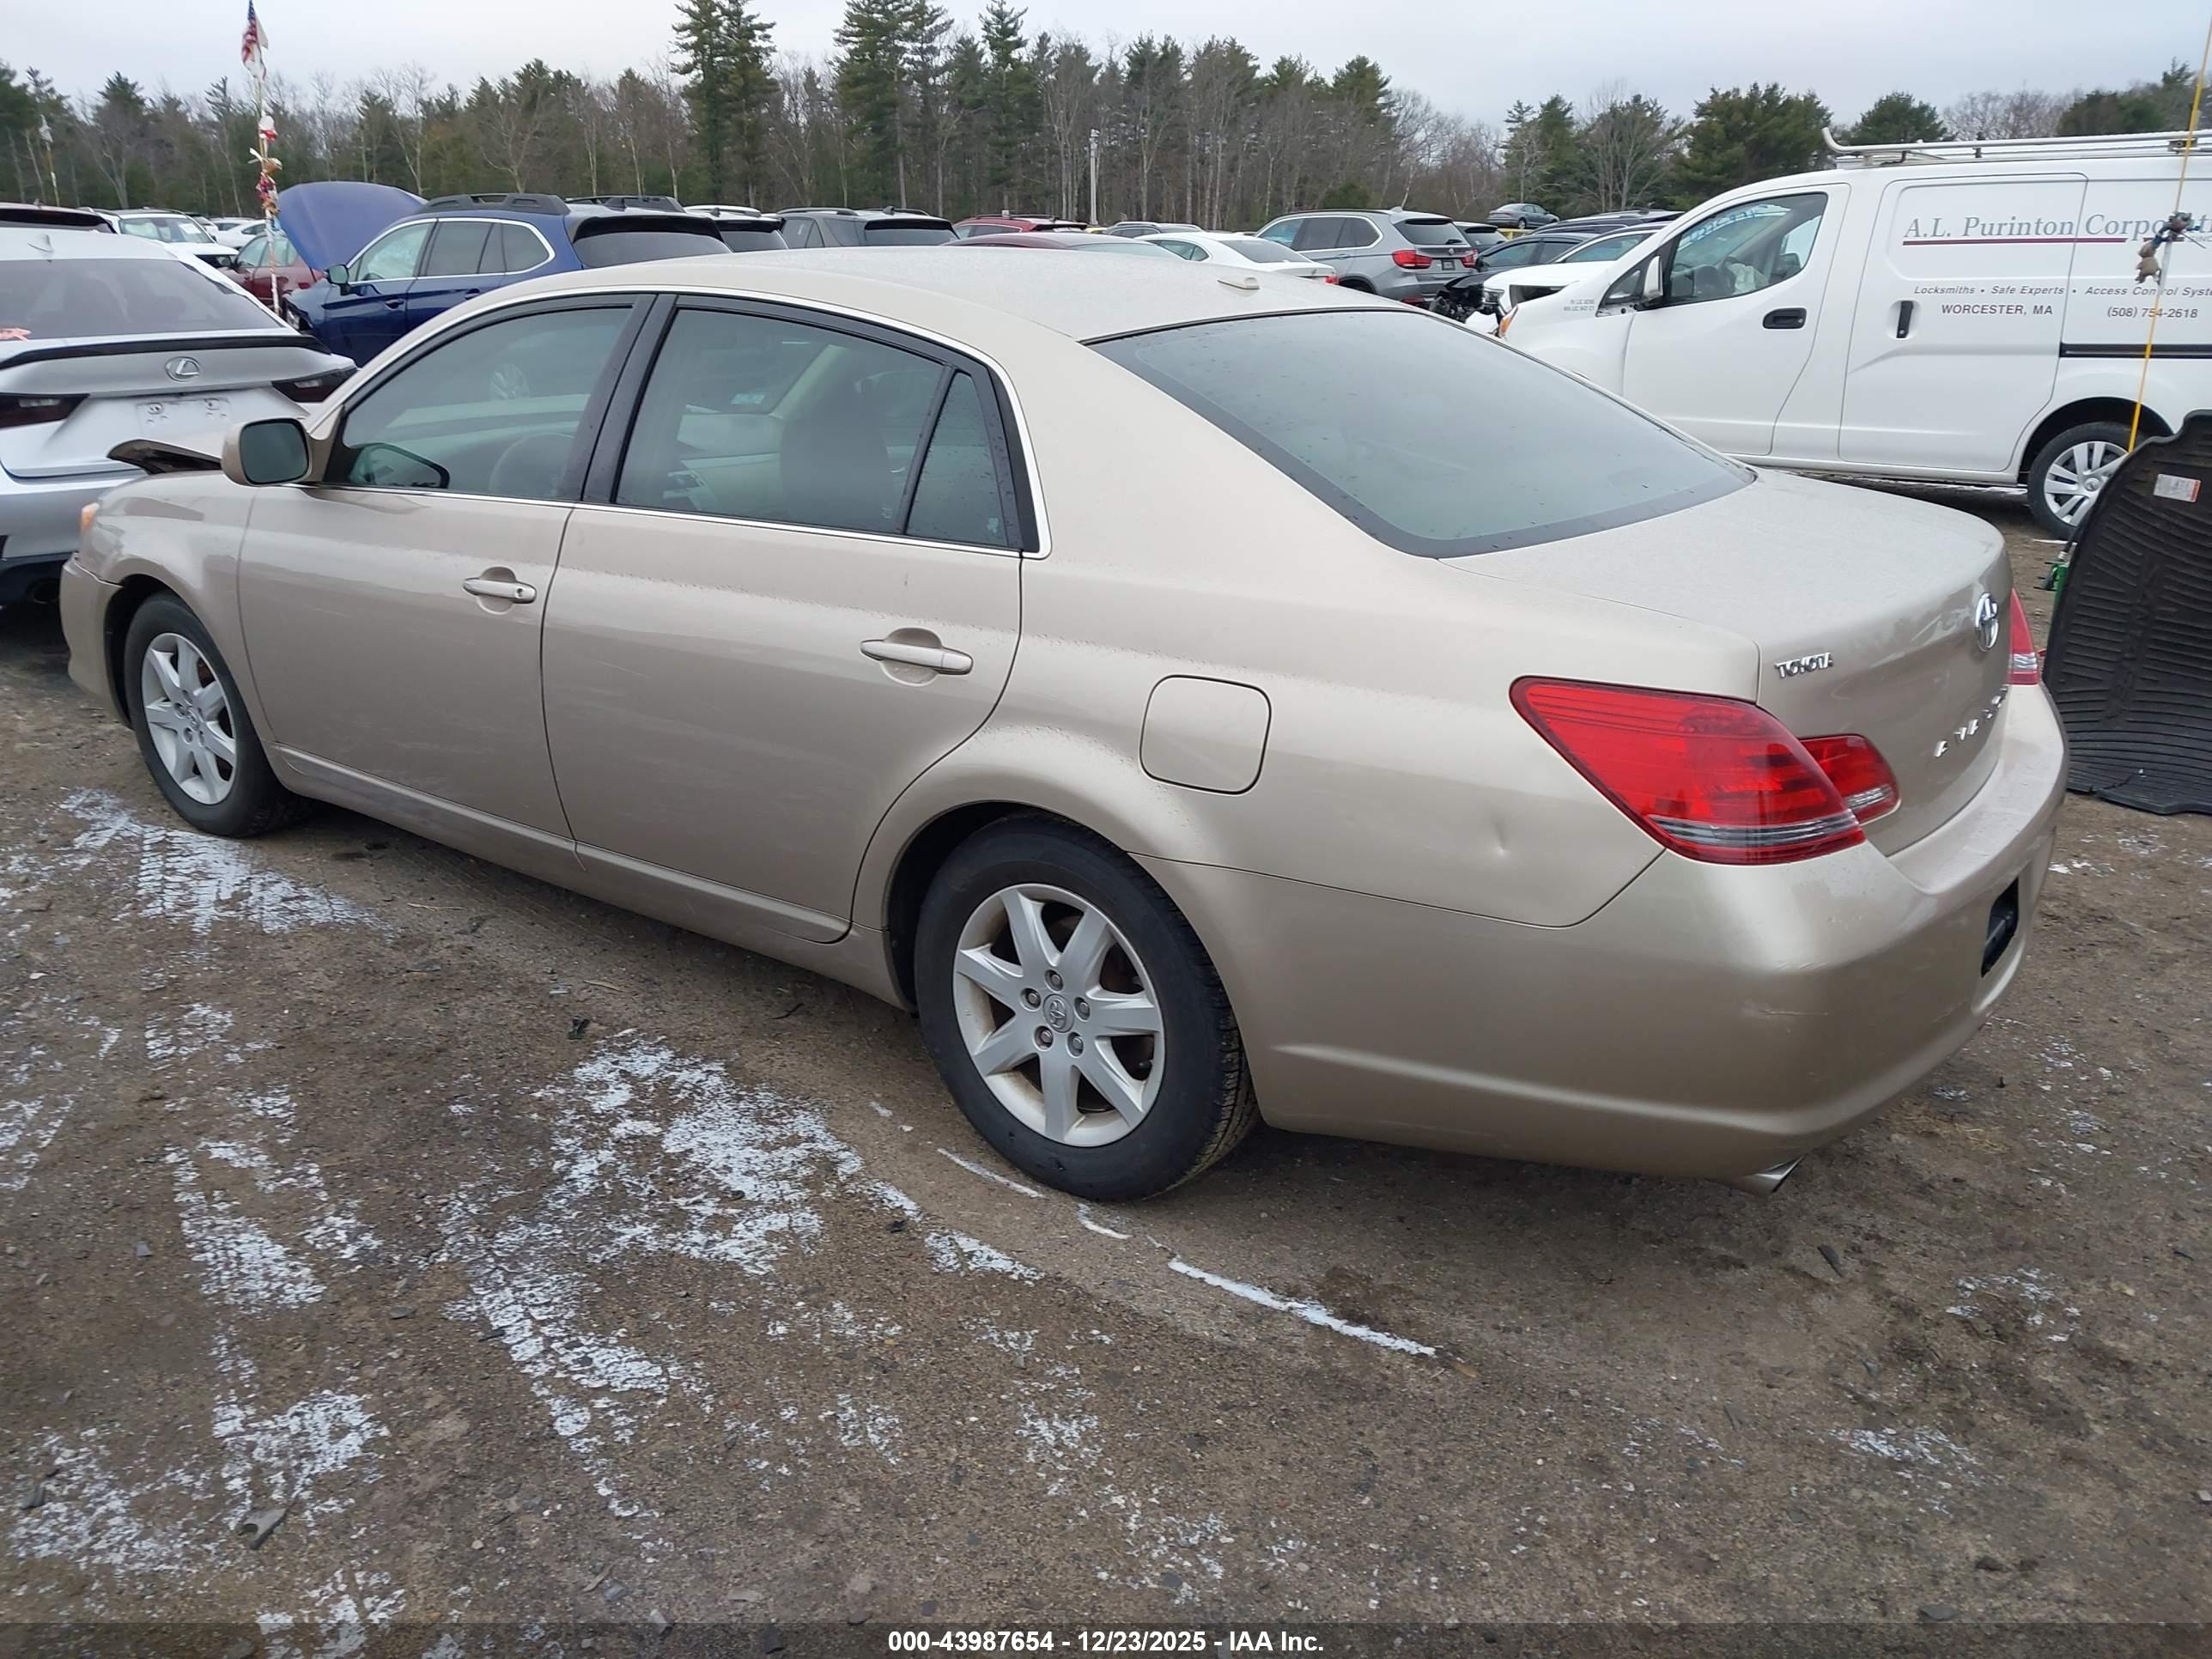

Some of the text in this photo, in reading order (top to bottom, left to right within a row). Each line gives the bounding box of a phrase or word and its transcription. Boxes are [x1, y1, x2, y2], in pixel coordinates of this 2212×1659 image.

[1903, 214, 2212, 241] A.L. Purinton Corpot
[1914, 285, 1976, 295] Locksmiths
[1990, 285, 2016, 295] Safe
[2020, 285, 2064, 295] Experts
[2085, 286, 2127, 295] Access
[2132, 286, 2179, 295] Conrol
[1942, 304, 2053, 316] WORCESTER, MA
[2107, 306, 2198, 319] (508) 754-2618
[1774, 653, 1833, 678] TOYOTA
